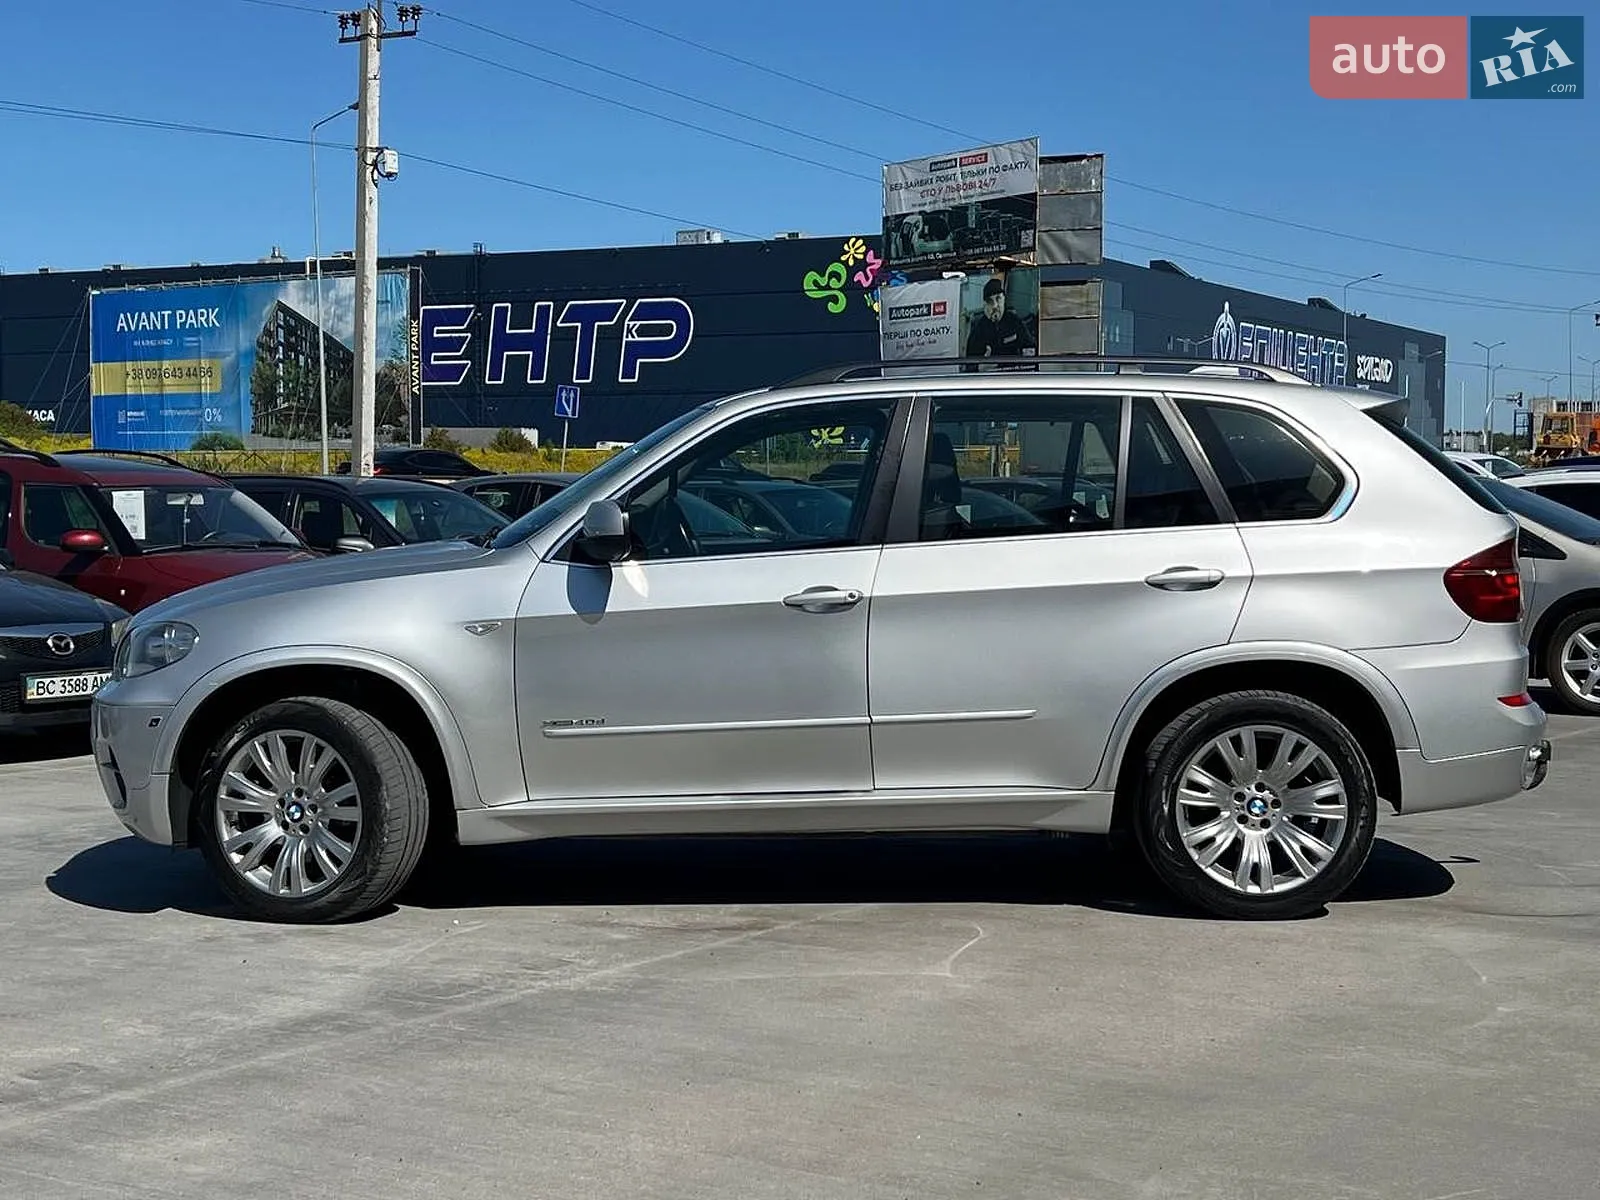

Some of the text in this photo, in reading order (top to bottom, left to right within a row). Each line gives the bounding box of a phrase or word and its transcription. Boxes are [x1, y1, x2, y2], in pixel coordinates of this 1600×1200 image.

[988, 165, 999, 175] ПО
[891, 303, 929, 319] Autopark
[116, 306, 221, 333] AVANT PARK
[909, 328, 922, 339] ПО
[410, 319, 420, 395] AVANT PARK
[204, 408, 223, 423] 0%
[36, 680, 56, 696] BC
[59, 676, 89, 695] 3588
